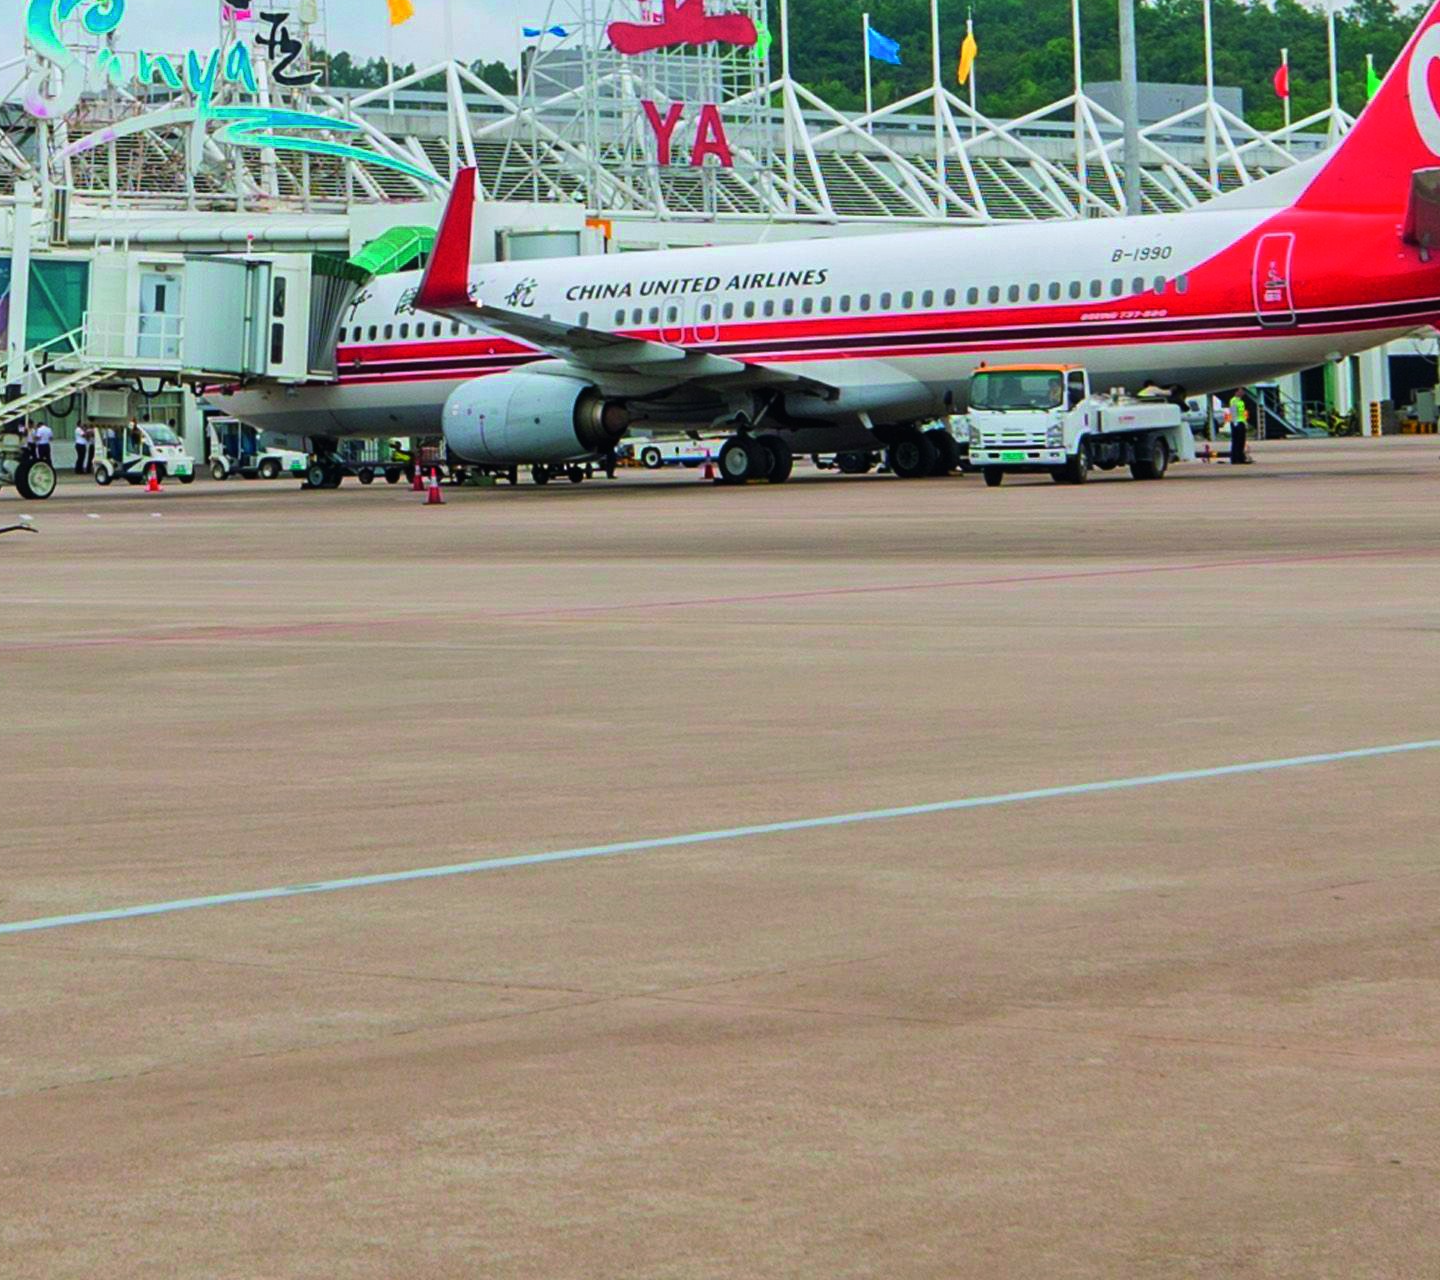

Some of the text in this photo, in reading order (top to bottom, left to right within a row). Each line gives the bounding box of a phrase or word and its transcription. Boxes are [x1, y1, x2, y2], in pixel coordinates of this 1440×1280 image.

[639, 99, 734, 169] YA
[1111, 245, 1173, 263] B-1990
[565, 268, 829, 301] CHINA UNITED AIRLINES
